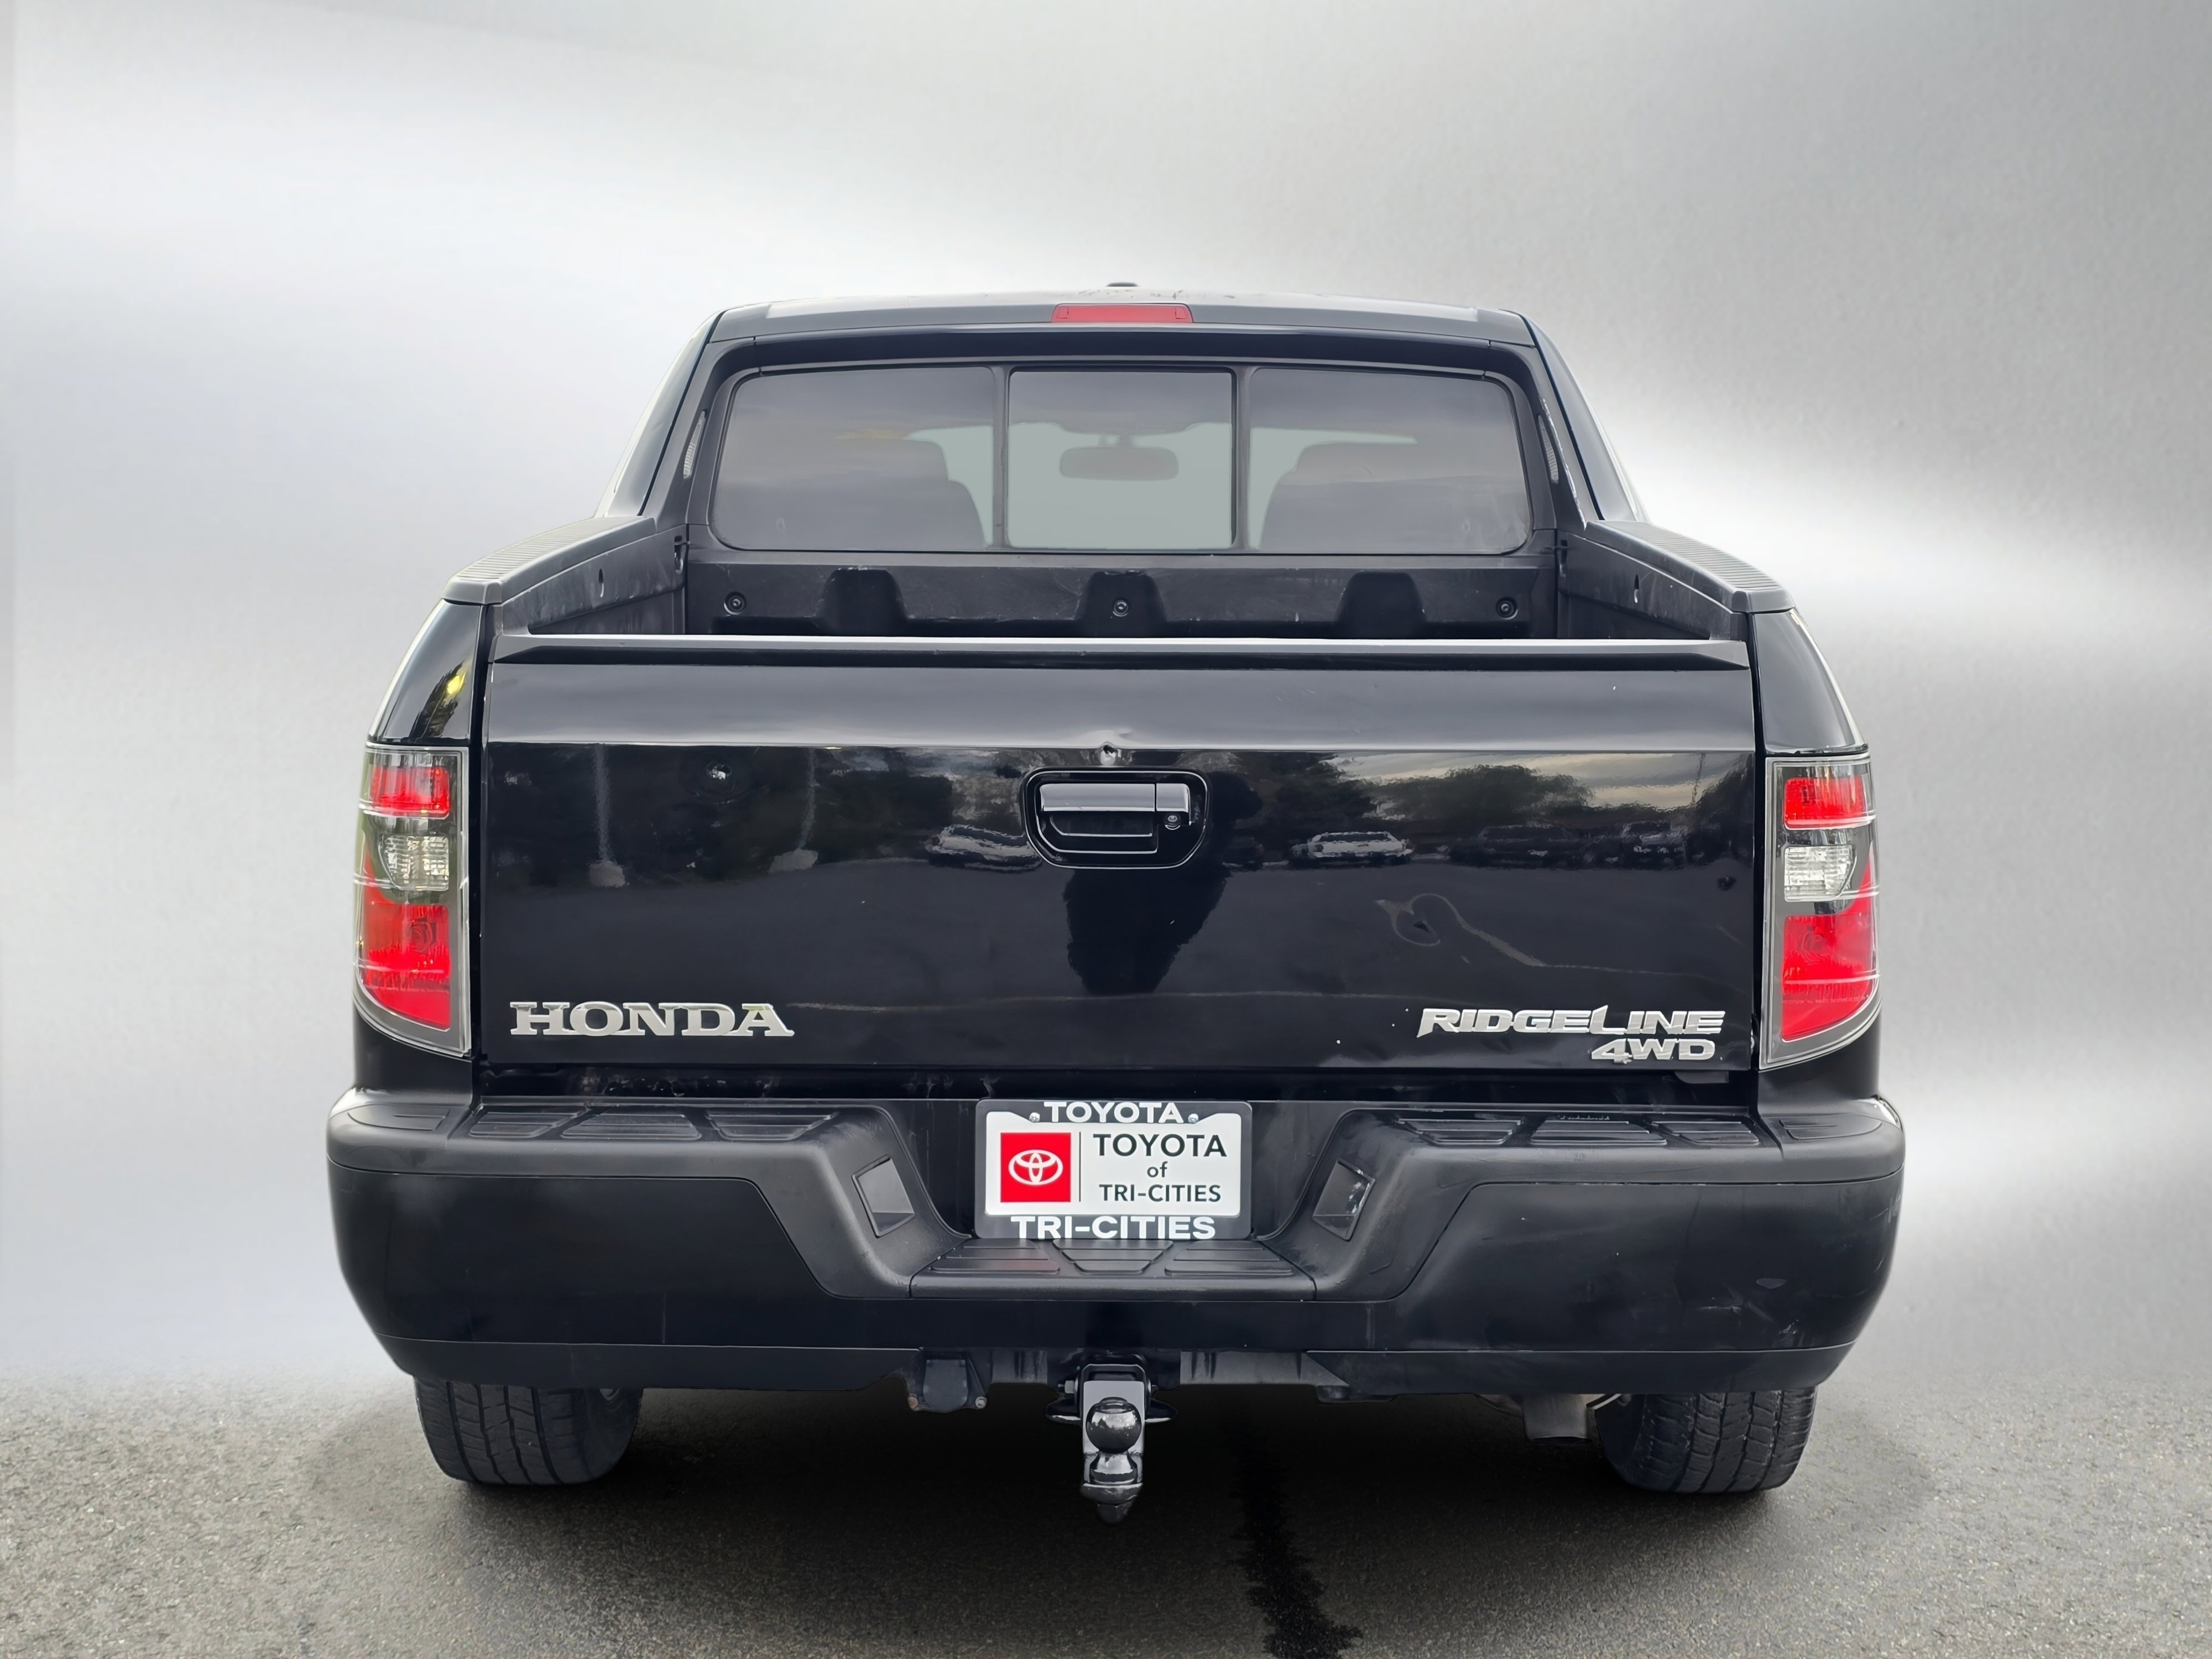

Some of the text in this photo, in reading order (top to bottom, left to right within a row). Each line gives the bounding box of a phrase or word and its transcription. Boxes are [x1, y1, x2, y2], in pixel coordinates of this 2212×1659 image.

[510, 1001, 795, 1036] HONDA
[1417, 1005, 1725, 1037] RIDGELINE
[1591, 1038, 1715, 1063] 4WD
[1044, 1102, 1184, 1123] TOYOTA
[1093, 1134, 1227, 1157] TOYOTA
[1147, 1162, 1168, 1178] of
[1099, 1184, 1221, 1202] TRI-CITIES
[1010, 1216, 1215, 1239] TRI-CITIES
